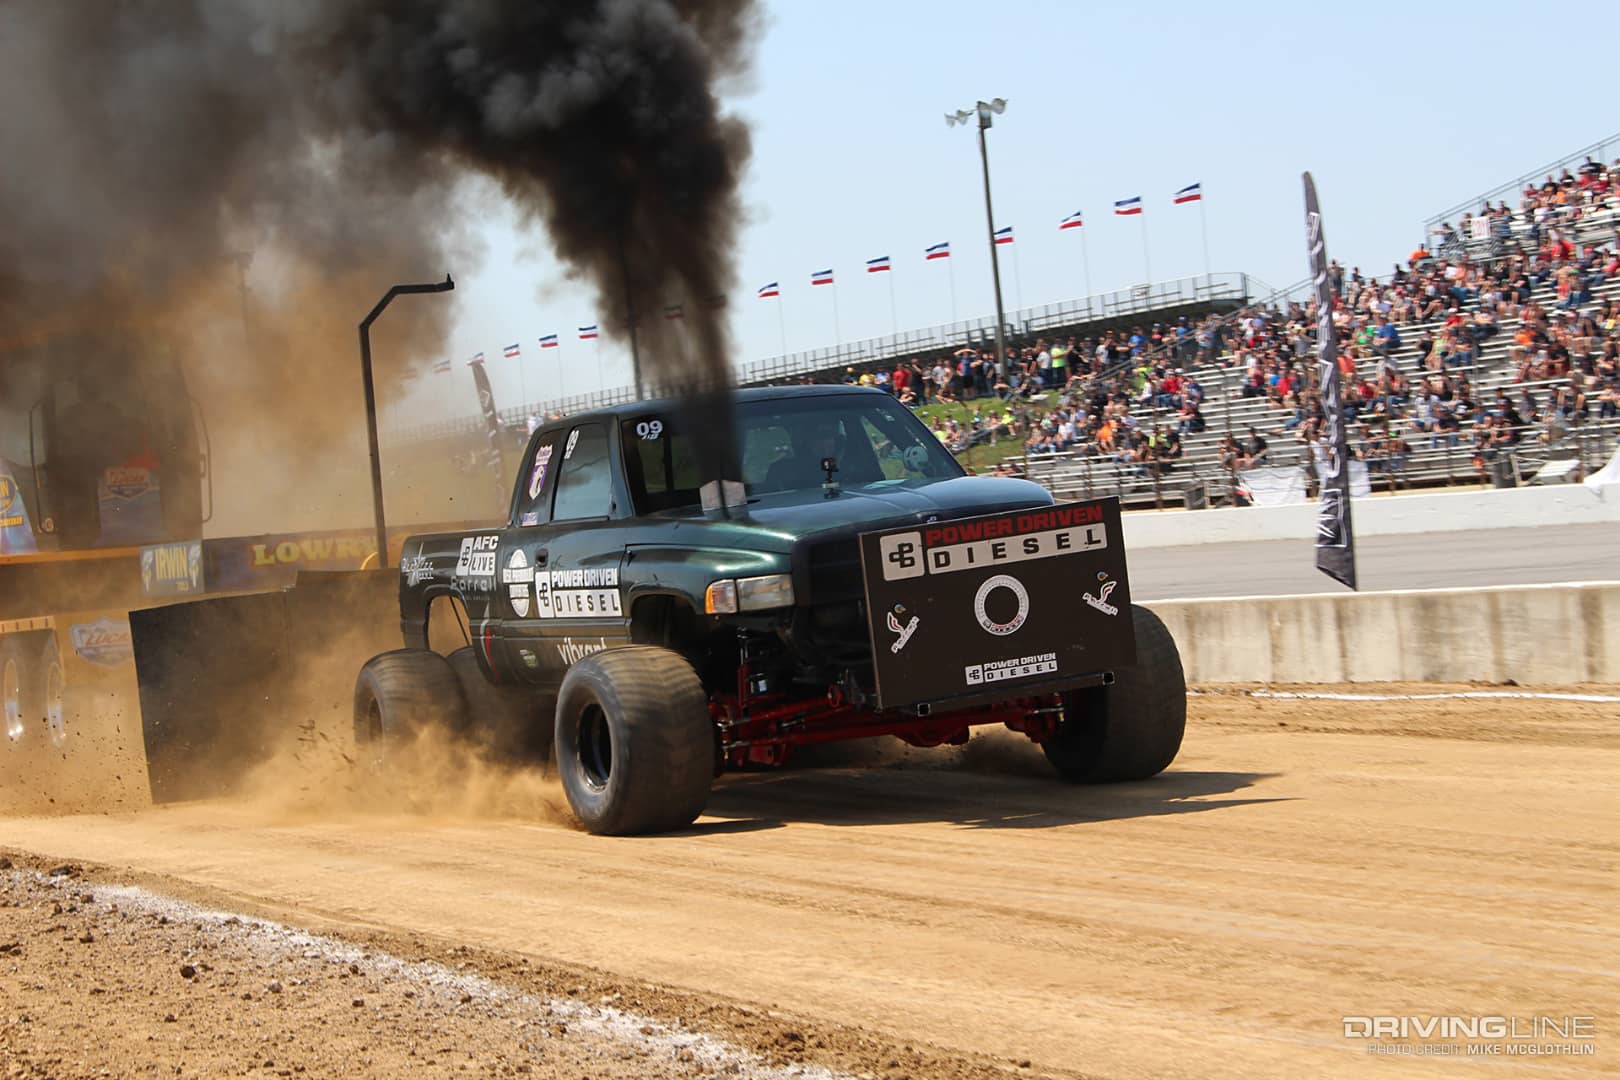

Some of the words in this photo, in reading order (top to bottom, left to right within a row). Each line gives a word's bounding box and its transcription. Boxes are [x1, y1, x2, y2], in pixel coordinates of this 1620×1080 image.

[636, 420, 663, 436] 09
[926, 517, 1014, 547] POWER
[1016, 505, 1103, 533] DRIVEN
[473, 536, 499, 550] AFC
[934, 529, 1102, 569] DIESEL
[154, 545, 188, 580] IRWIN
[471, 556, 494, 571] LIVE
[552, 569, 583, 588] POWER
[583, 568, 618, 587] DRIVEN
[555, 593, 619, 612] DIESEL
[984, 657, 1019, 670] POWER
[1020, 653, 1056, 666] DRIVEN
[987, 662, 1055, 680] DIESEL
